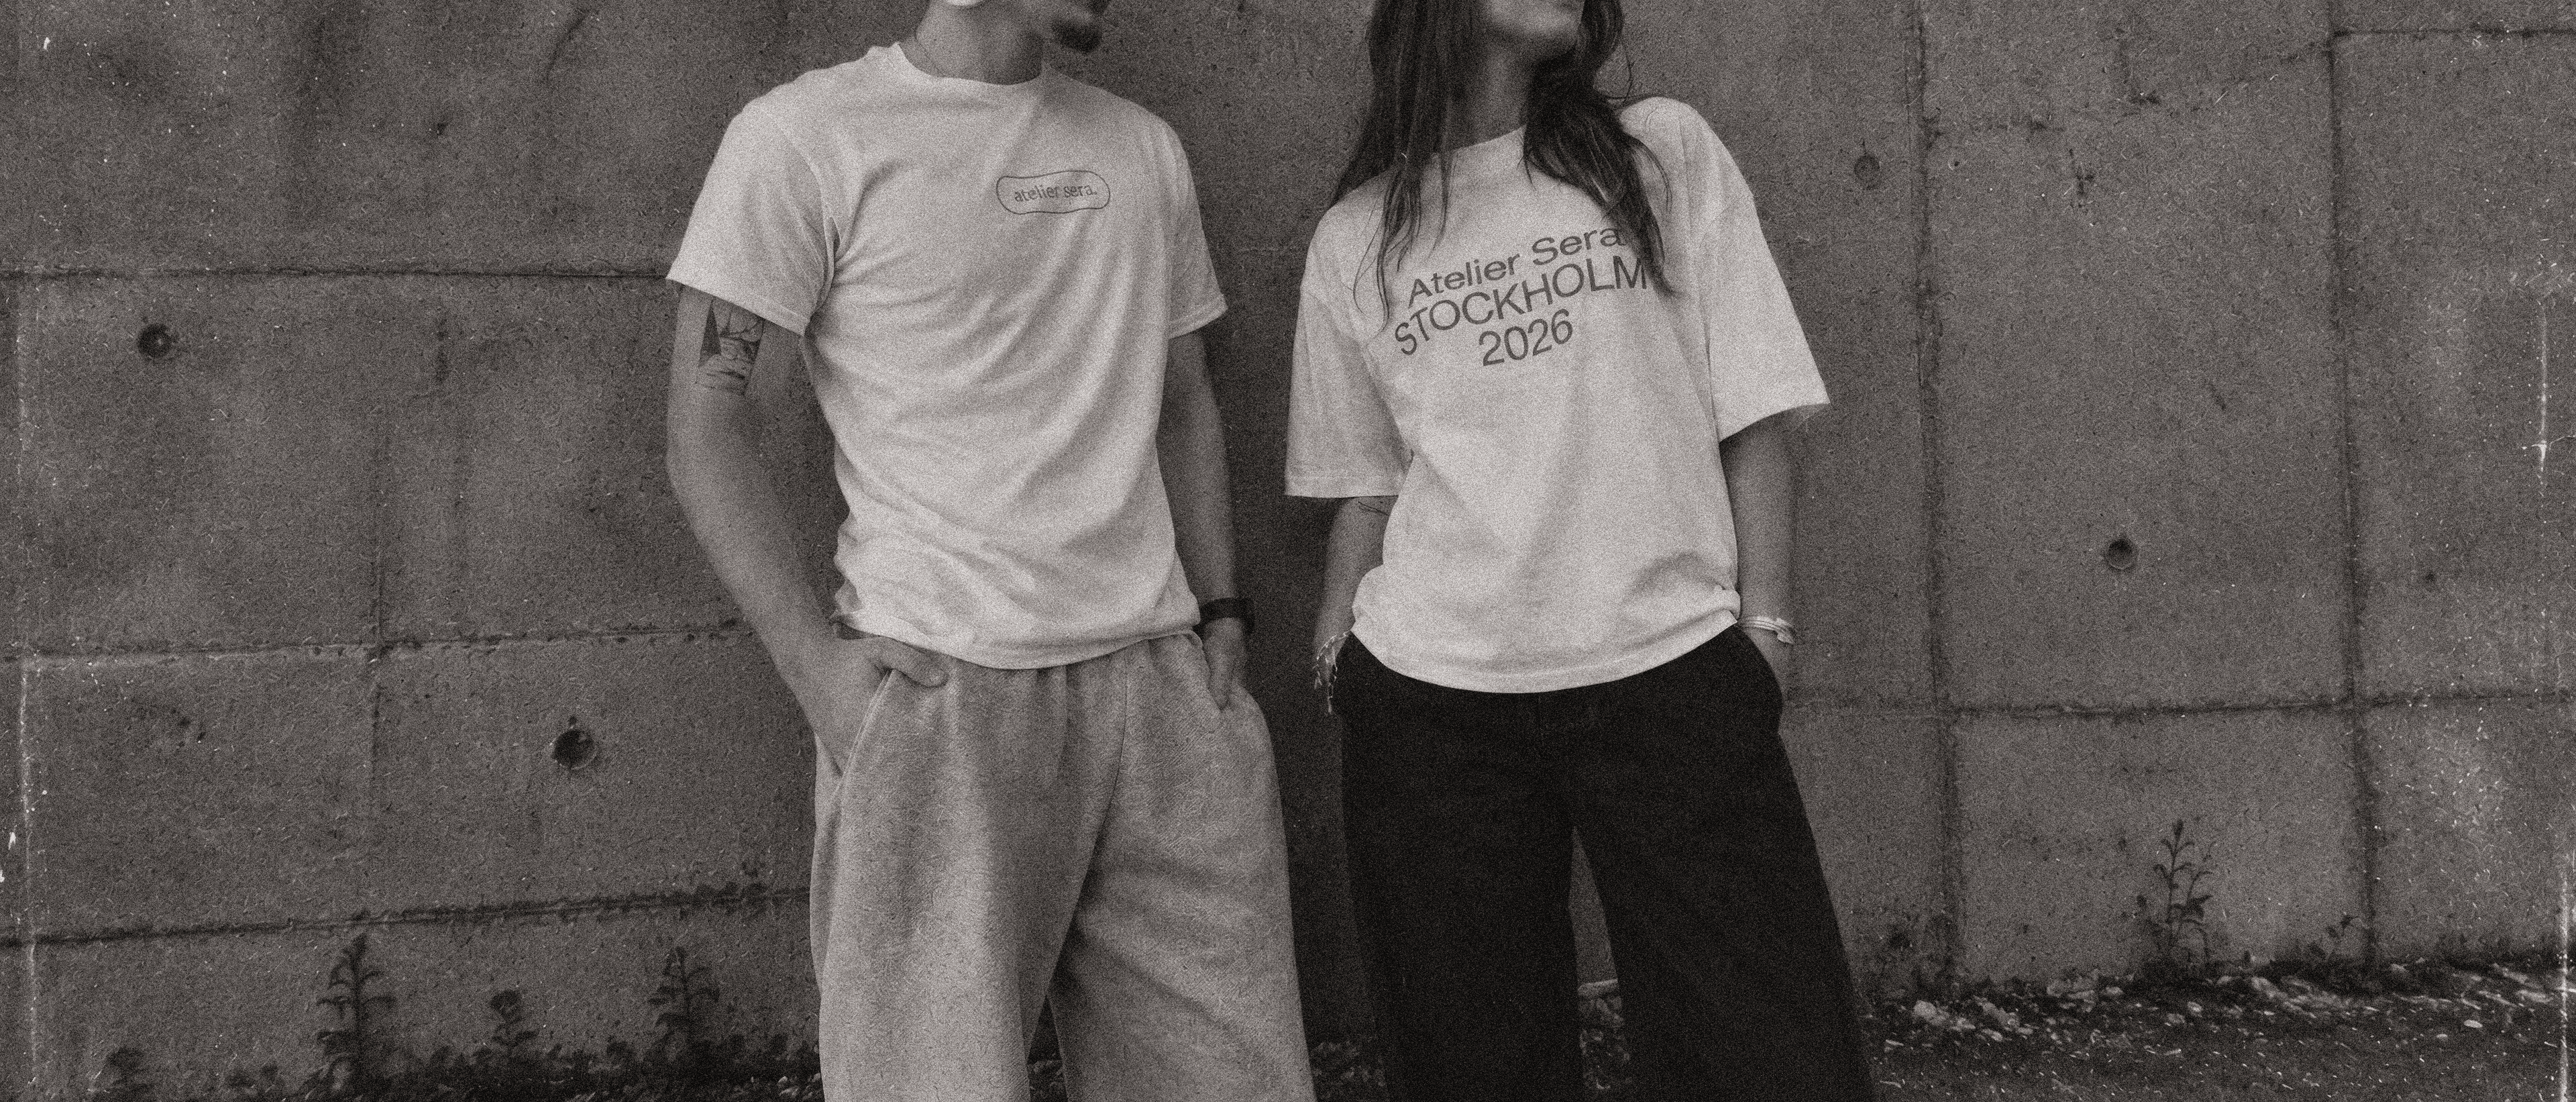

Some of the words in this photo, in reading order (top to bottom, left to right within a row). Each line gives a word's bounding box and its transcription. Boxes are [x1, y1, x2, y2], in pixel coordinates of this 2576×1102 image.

[1014, 184, 1059, 202] atelier
[1063, 185, 1097, 198] sera.
[1409, 253, 1520, 308] Atelier
[1532, 227, 1627, 266] Sera
[1395, 255, 1648, 355] STOCKHOLM
[1479, 308, 1573, 366] 2026
